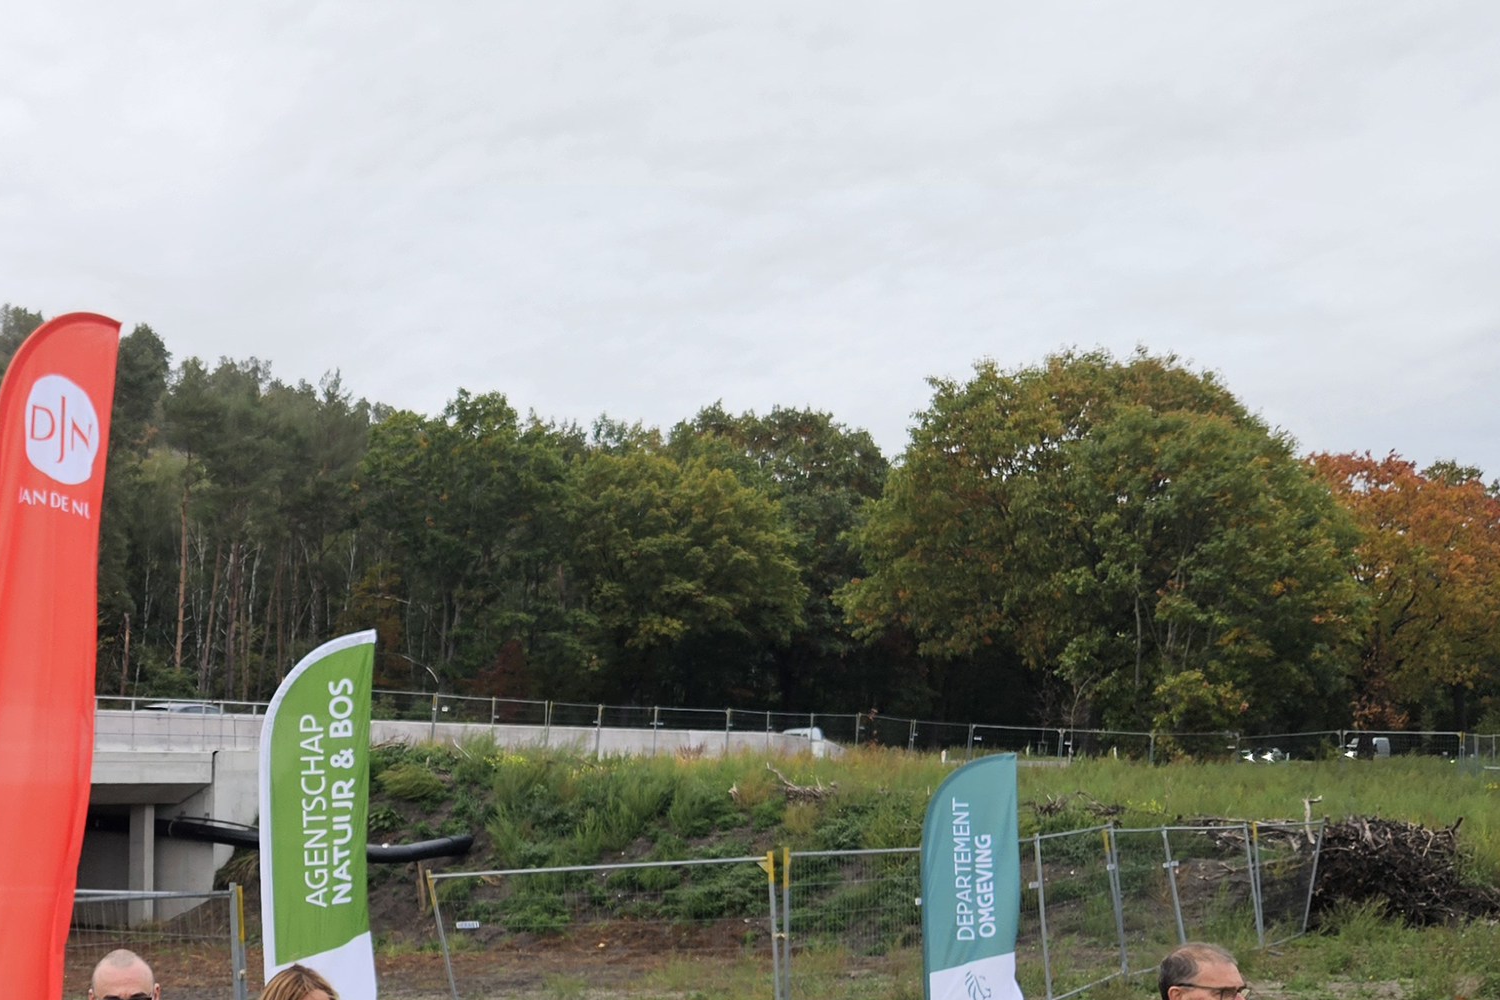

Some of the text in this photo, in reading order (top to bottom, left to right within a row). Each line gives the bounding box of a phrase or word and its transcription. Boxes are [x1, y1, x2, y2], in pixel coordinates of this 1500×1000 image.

[50, 491, 69, 512] DE
[299, 714, 328, 908] AGENTSCHAP
[328, 677, 355, 906] NATUUR & BOS
[952, 796, 975, 940] DEPARTEMENT
[974, 834, 997, 938] OMGEVING
